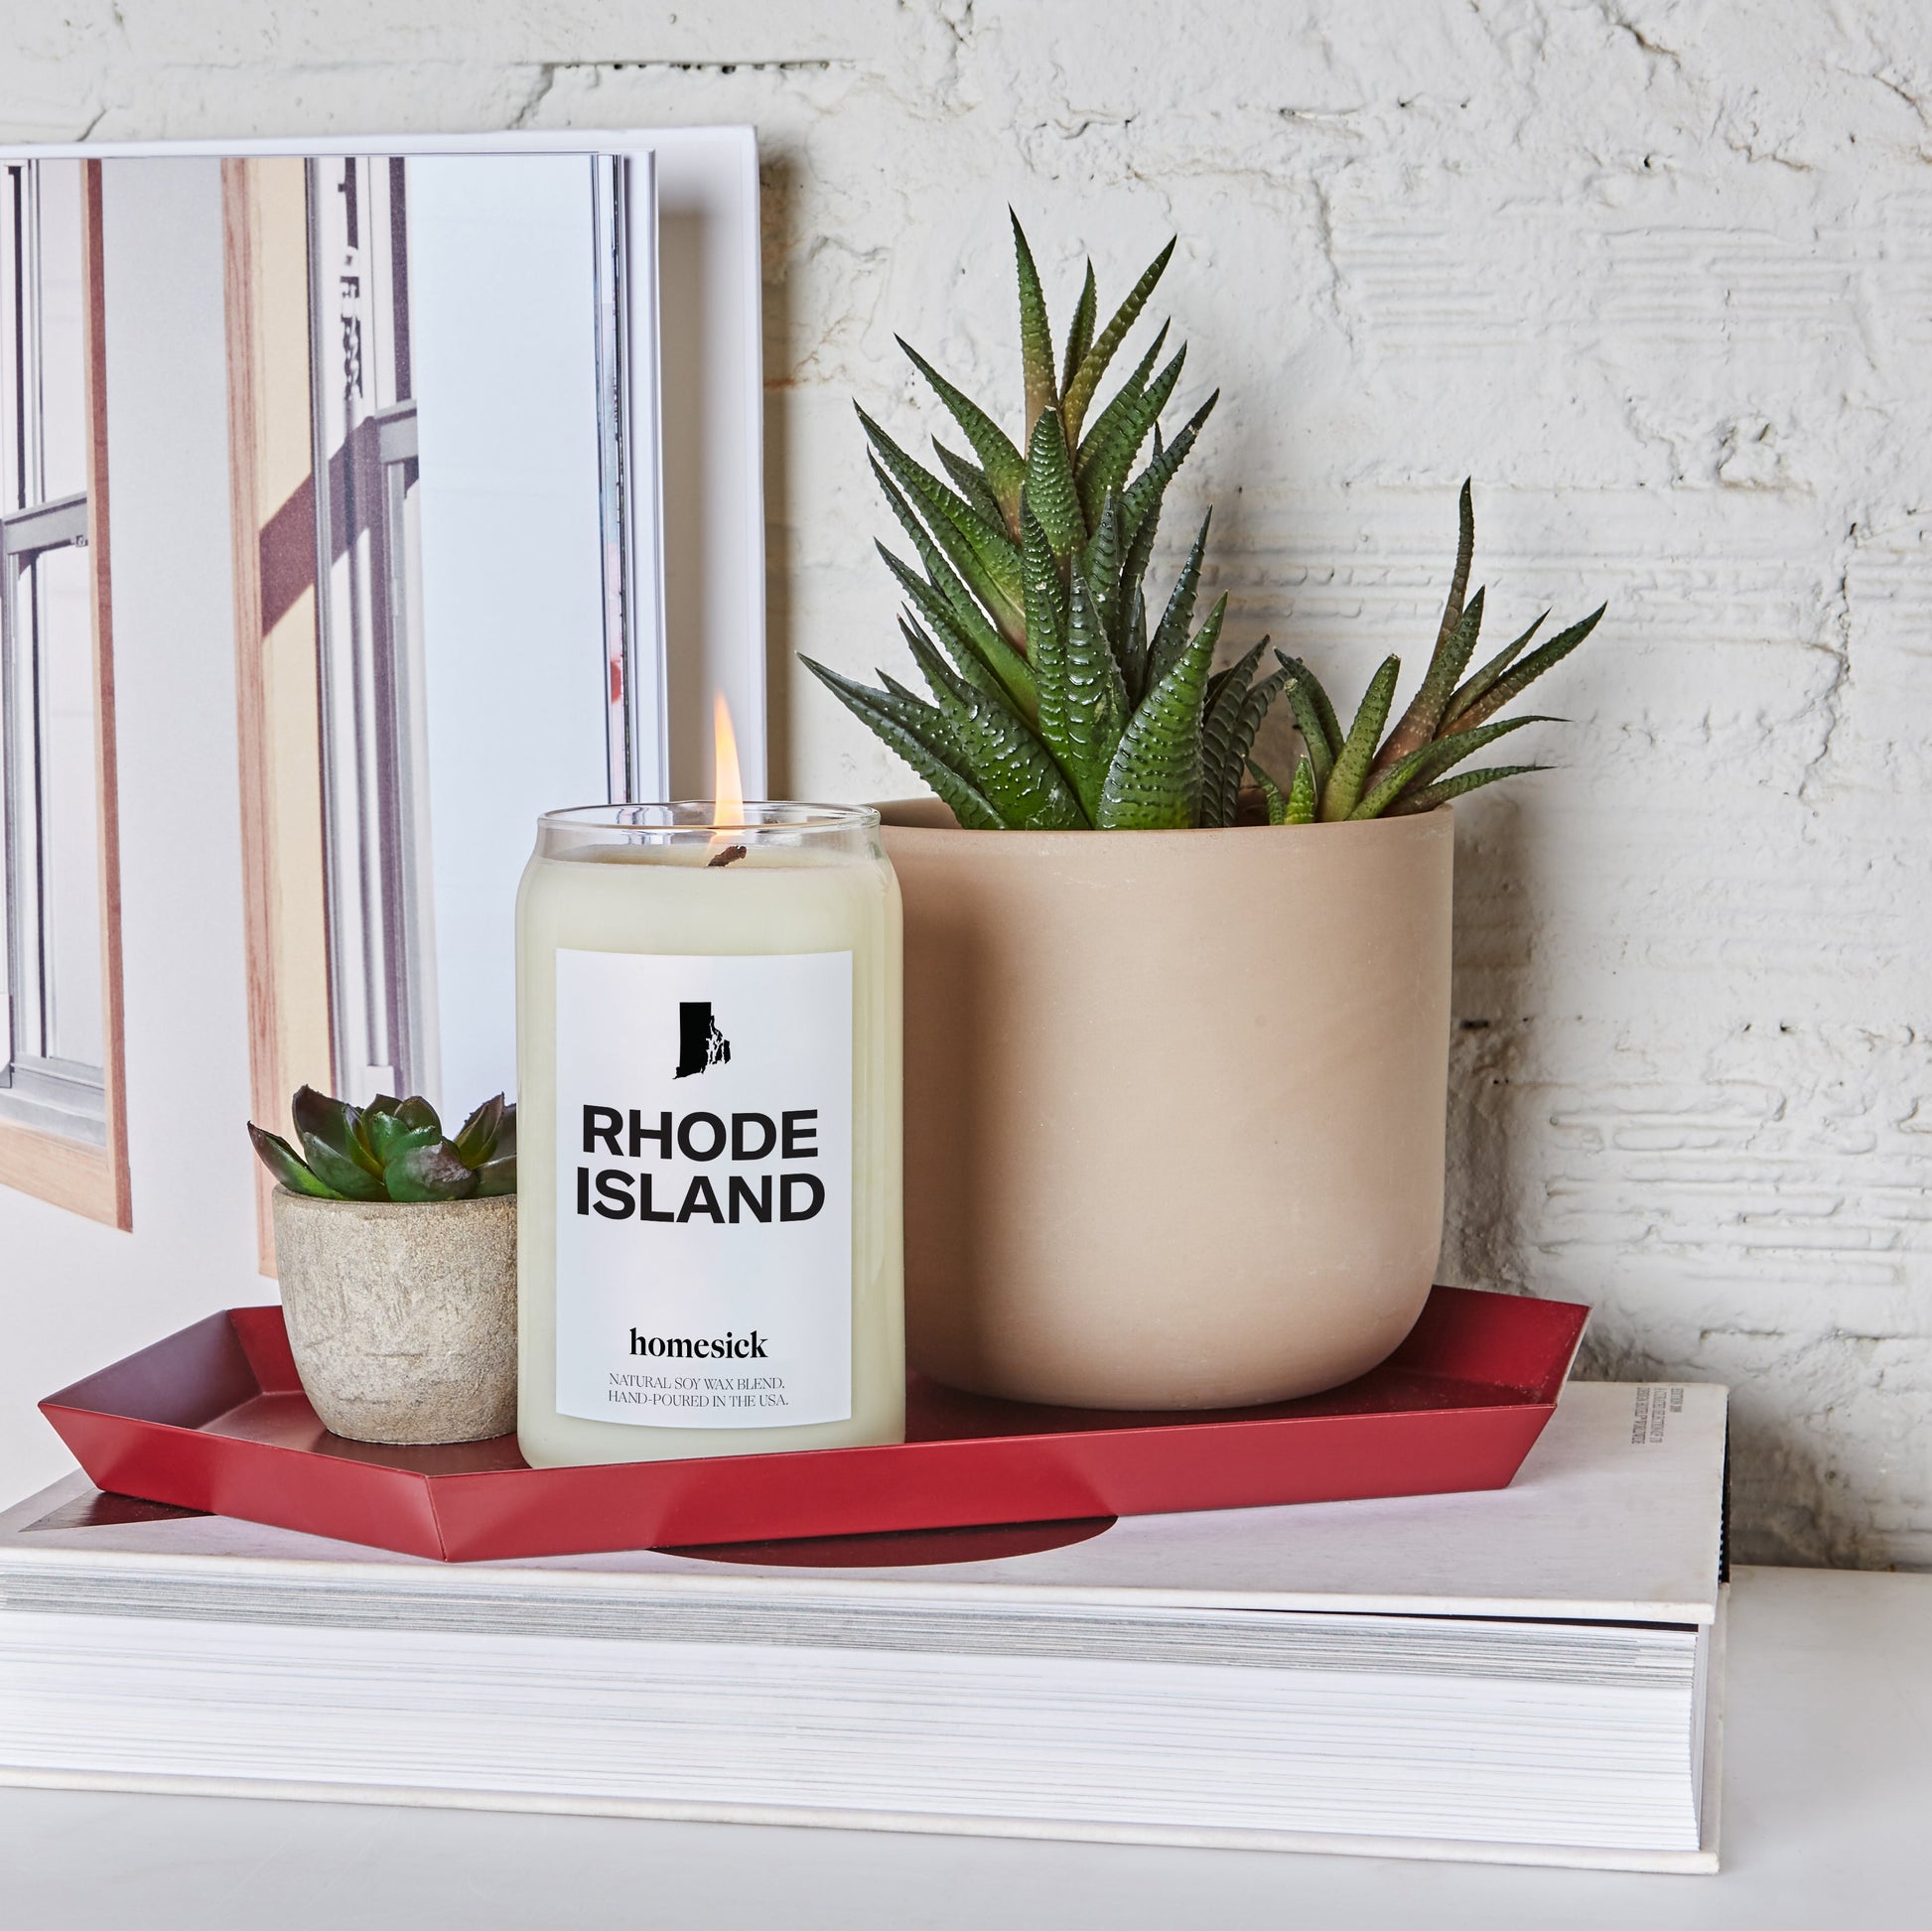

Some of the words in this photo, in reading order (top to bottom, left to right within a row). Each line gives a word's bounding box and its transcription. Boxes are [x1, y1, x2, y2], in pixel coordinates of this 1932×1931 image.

[583, 1104, 819, 1163] RHODE
[576, 1167, 826, 1224] ISLAND
[628, 1327, 769, 1359] homesick
[609, 1372, 672, 1389] NATURAL
[674, 1376, 702, 1390] SOY
[703, 1377, 735, 1391] WAX
[737, 1376, 785, 1391] BLEND.
[609, 1389, 710, 1408] HAND-POURED
[712, 1395, 727, 1408] IN
[728, 1394, 757, 1408] THE
[759, 1393, 789, 1408] USA.
